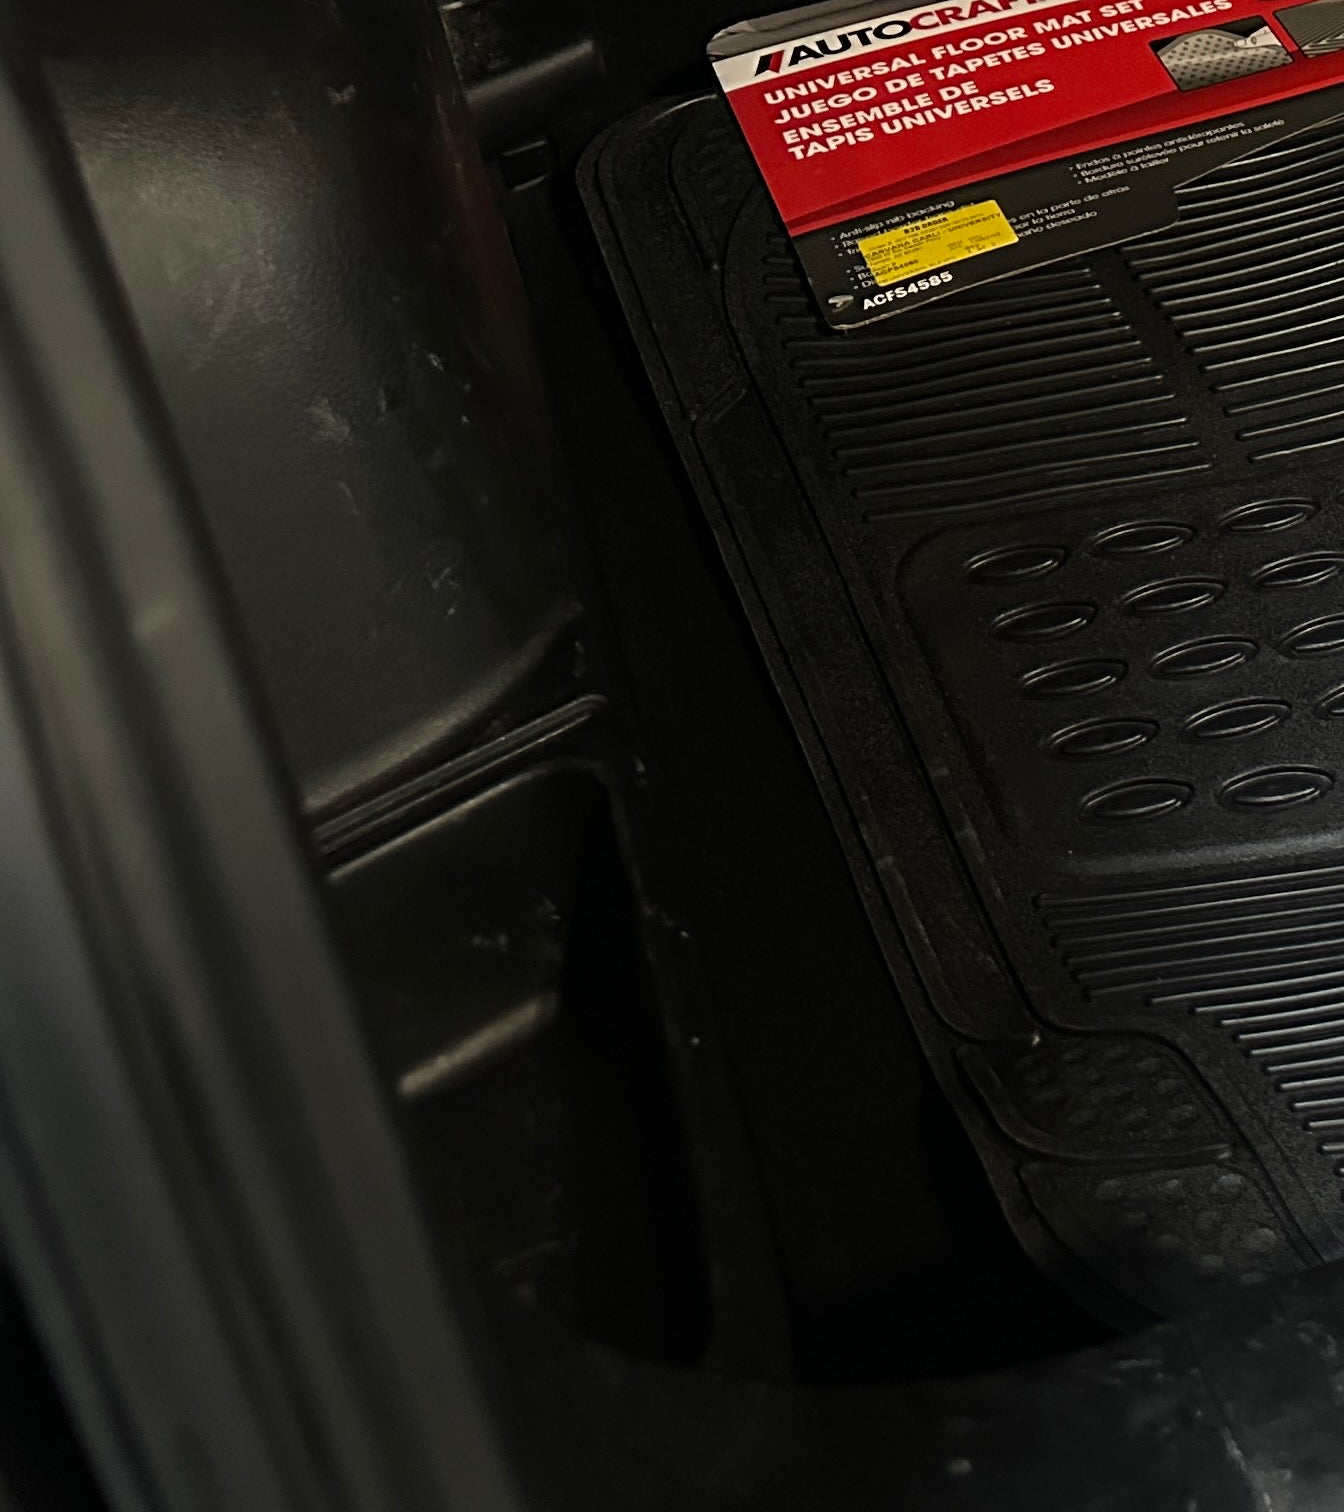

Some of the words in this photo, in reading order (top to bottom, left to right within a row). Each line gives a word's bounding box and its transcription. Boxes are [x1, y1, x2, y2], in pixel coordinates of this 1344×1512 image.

[763, 55, 927, 105] UNIVERSAL
[932, 26, 1027, 60] FLOOR
[1033, 9, 1093, 35] MAT
[774, 86, 878, 125] JUEGO
[885, 73, 925, 93] DE
[929, 42, 1046, 80] TAPETES
[782, 93, 933, 144] ENSEMBLE
[938, 81, 979, 102] DE
[788, 127, 875, 161] TAPIS
[880, 79, 1055, 135] UNIVERSELS
[906, 200, 955, 219] backing
[1036, 207, 1048, 215] la
[1050, 199, 1081, 213] parte
[1083, 193, 1099, 202] de
[862, 270, 954, 310] ACFS4585
